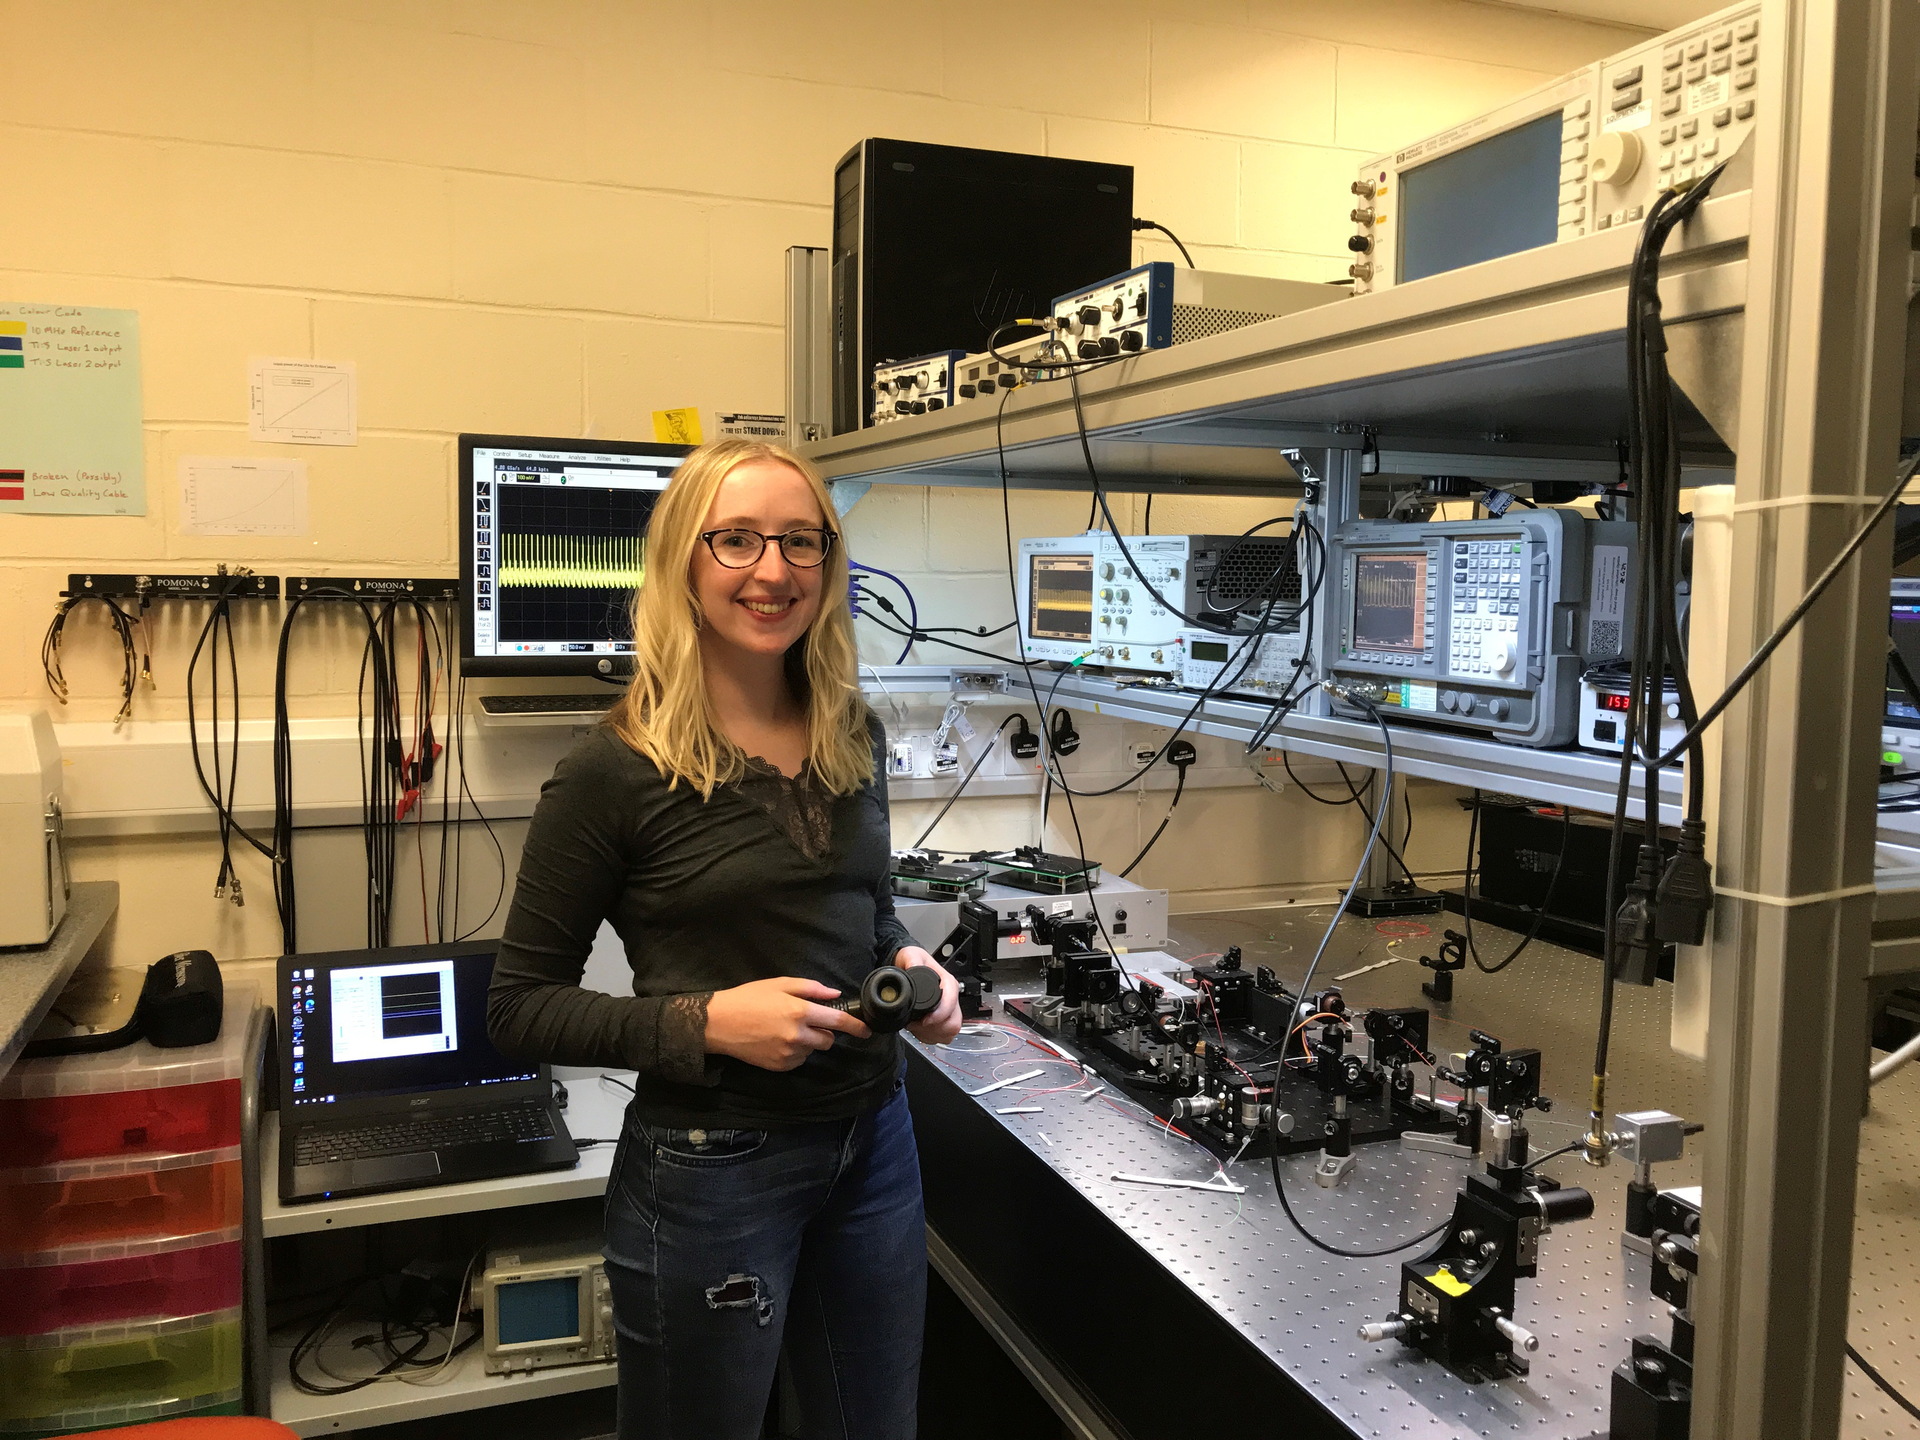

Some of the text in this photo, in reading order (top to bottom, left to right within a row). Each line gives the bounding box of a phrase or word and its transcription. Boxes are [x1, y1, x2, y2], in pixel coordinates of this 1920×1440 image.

[19, 307, 51, 315] Colour
[55, 307, 82, 317] Code
[31, 326, 41, 334] 10
[71, 325, 121, 337] Reference
[57, 343, 81, 352] Laser
[84, 344, 90, 352] 1
[93, 344, 122, 355] output
[55, 359, 81, 368] Laser
[85, 360, 92, 368] 2
[94, 360, 121, 370] output
[743, 426, 761, 435] STARE
[32, 470, 121, 485] Broken (Possibly)
[33, 488, 129, 500] Low Quality Cable
[157, 579, 201, 587] POMONA
[365, 581, 406, 589] POMONA
